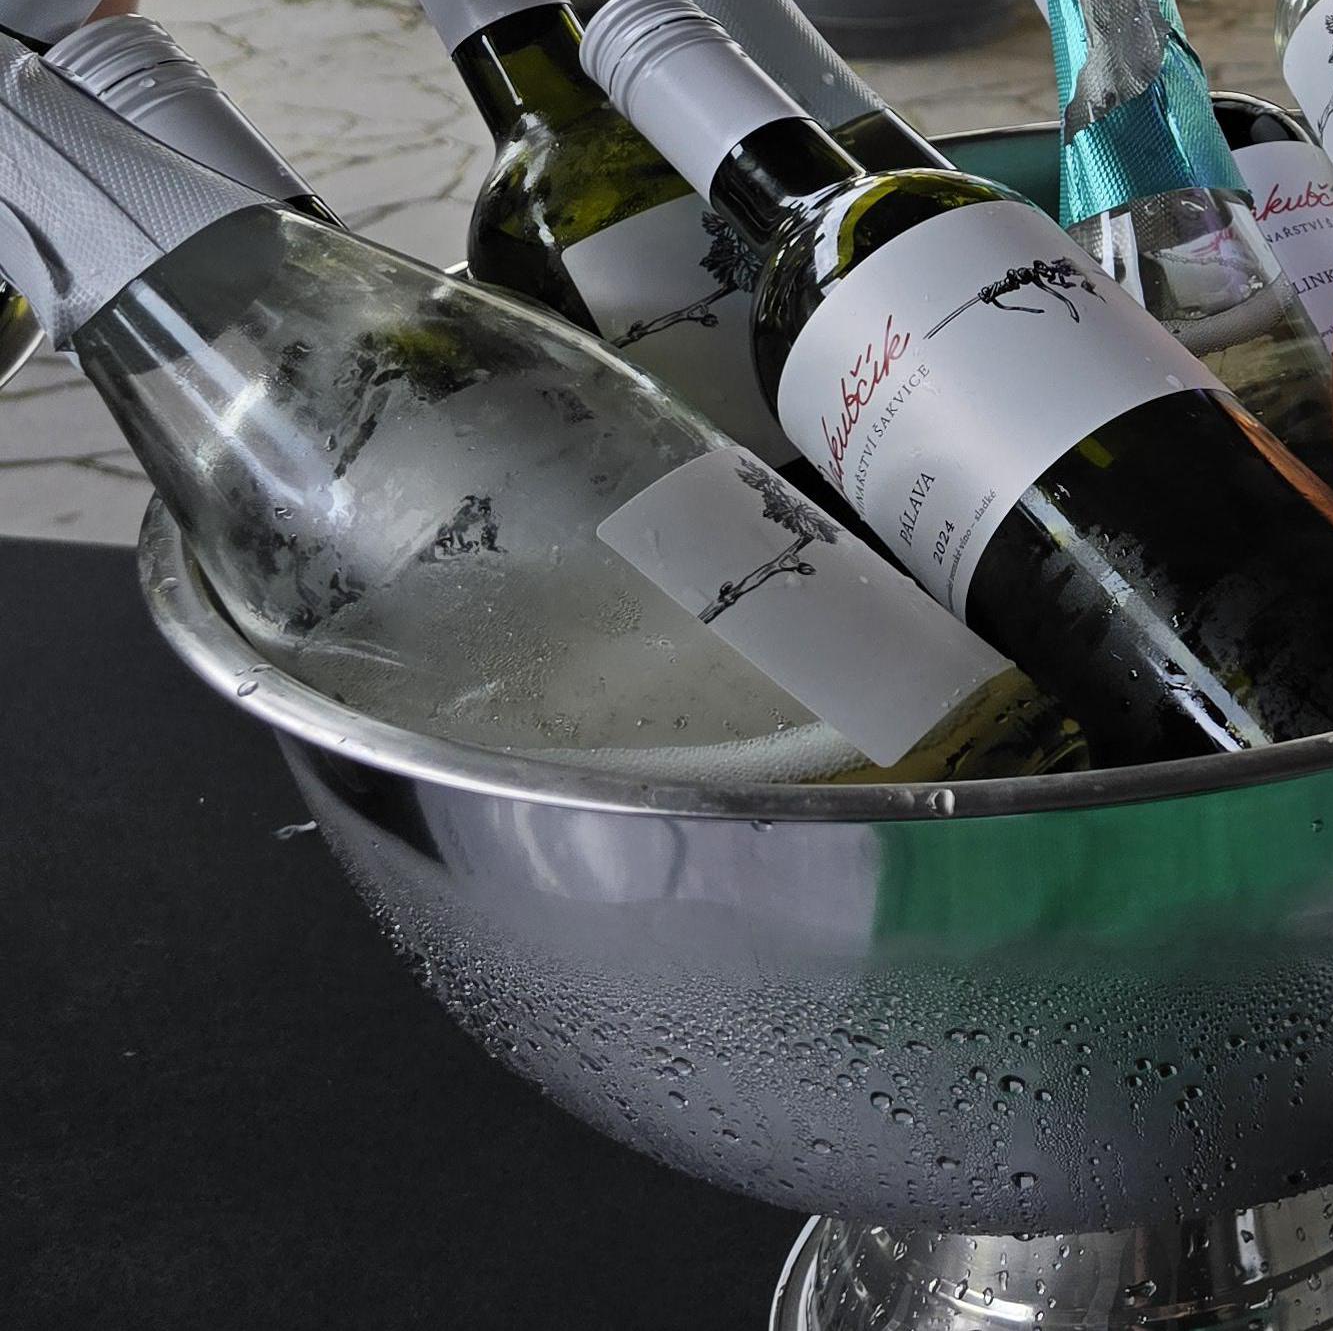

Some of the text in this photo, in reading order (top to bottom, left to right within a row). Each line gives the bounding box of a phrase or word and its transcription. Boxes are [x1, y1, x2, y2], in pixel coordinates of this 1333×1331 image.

[872, 364, 931, 438] ŠAKVICE
[899, 472, 936, 547] PÁLAVA
[974, 488, 998, 522] sladké
[932, 519, 956, 565] 2024
